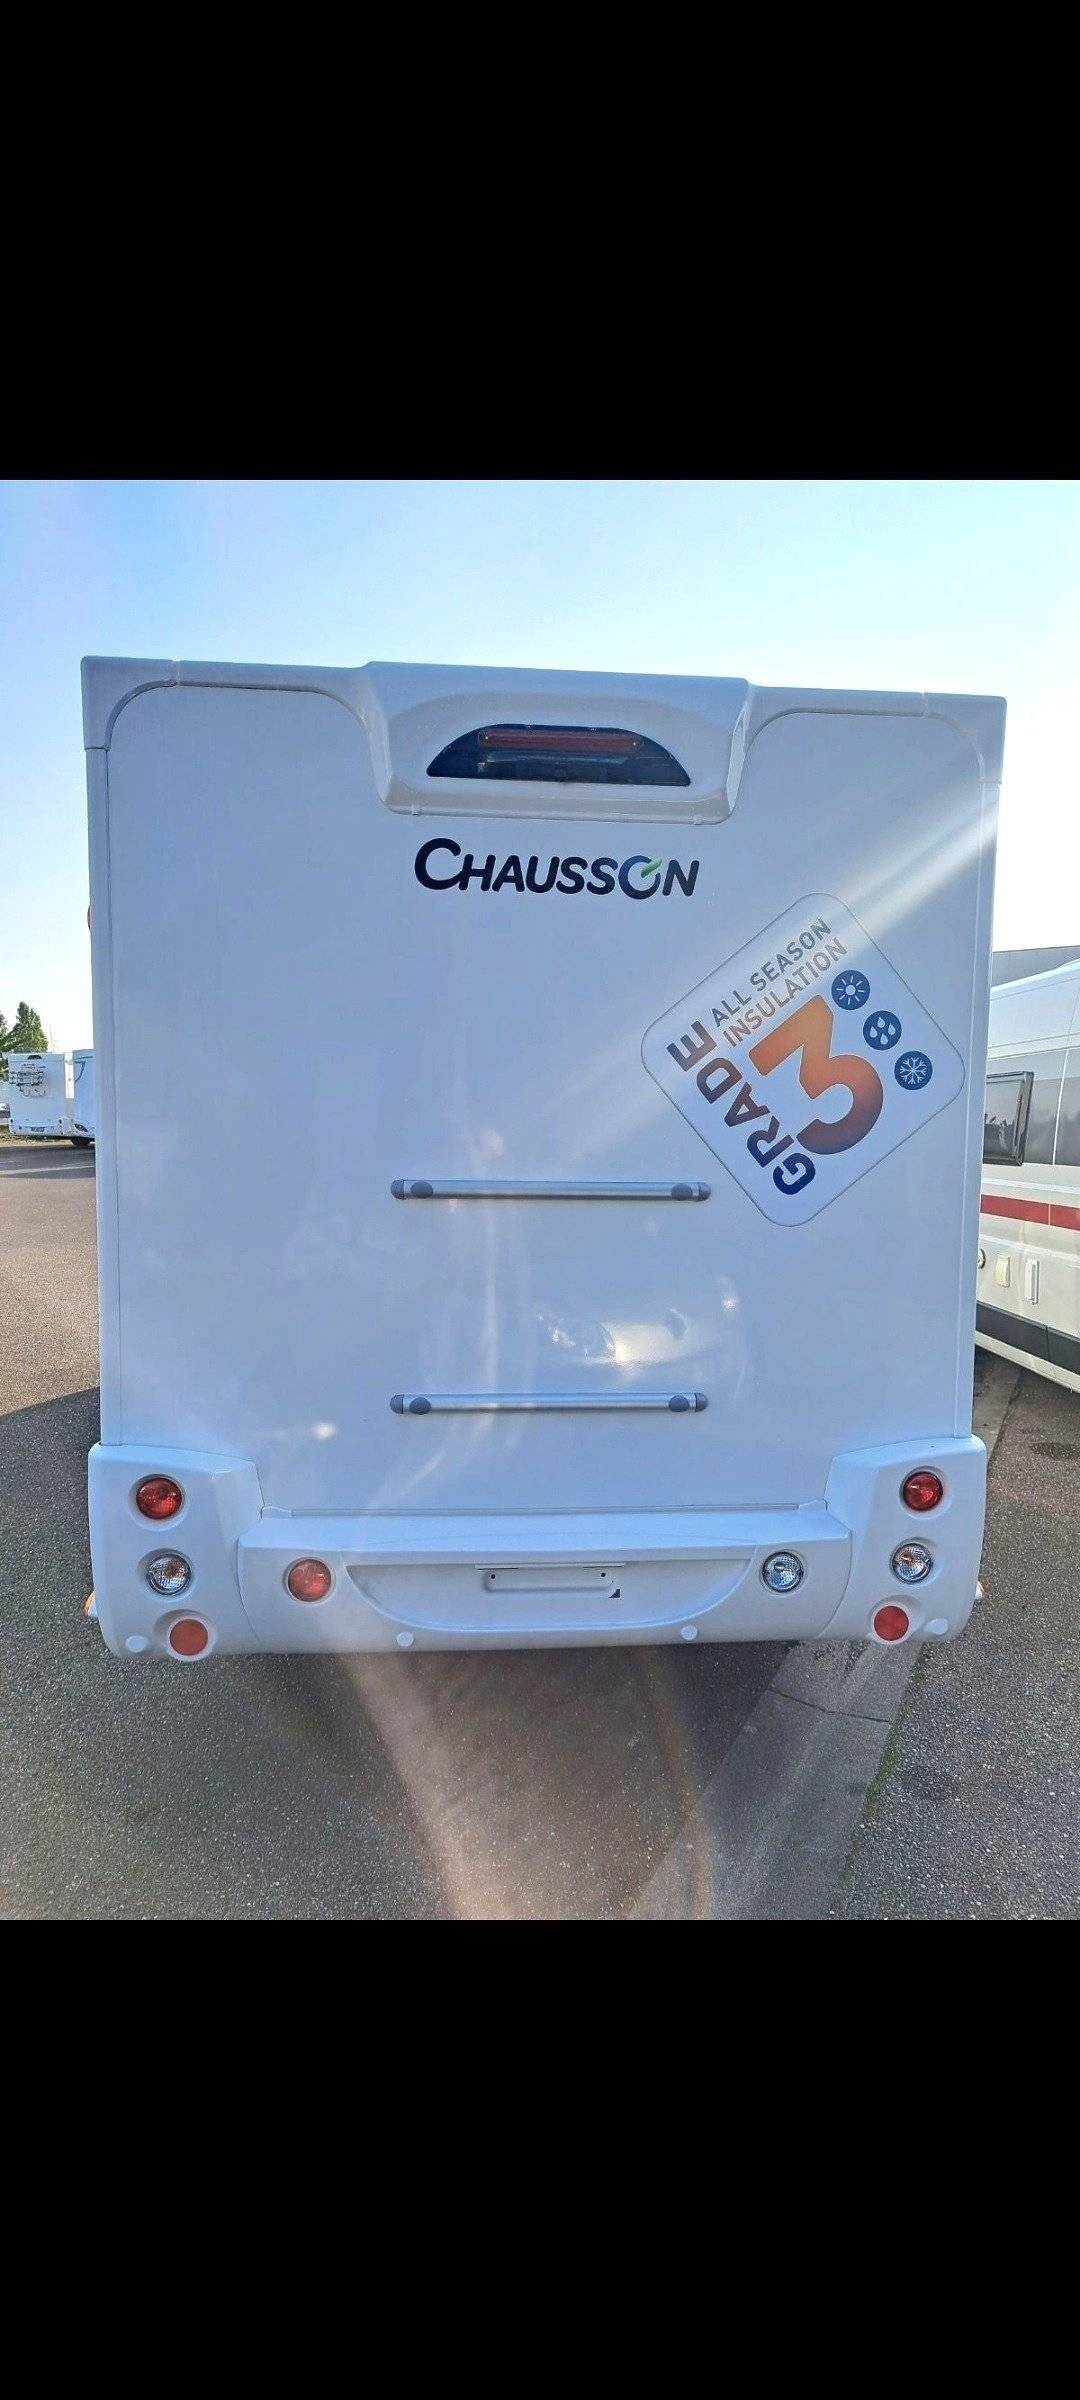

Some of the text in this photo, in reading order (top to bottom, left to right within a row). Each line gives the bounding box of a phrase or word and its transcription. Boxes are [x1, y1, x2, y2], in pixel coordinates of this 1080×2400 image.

[414, 837, 700, 900] CHAUSSON
[711, 917, 832, 1027] ALL SEASON
[722, 937, 848, 1047] INSULATION
[666, 1020, 816, 1195] GRADE
[748, 994, 884, 1155] 3
